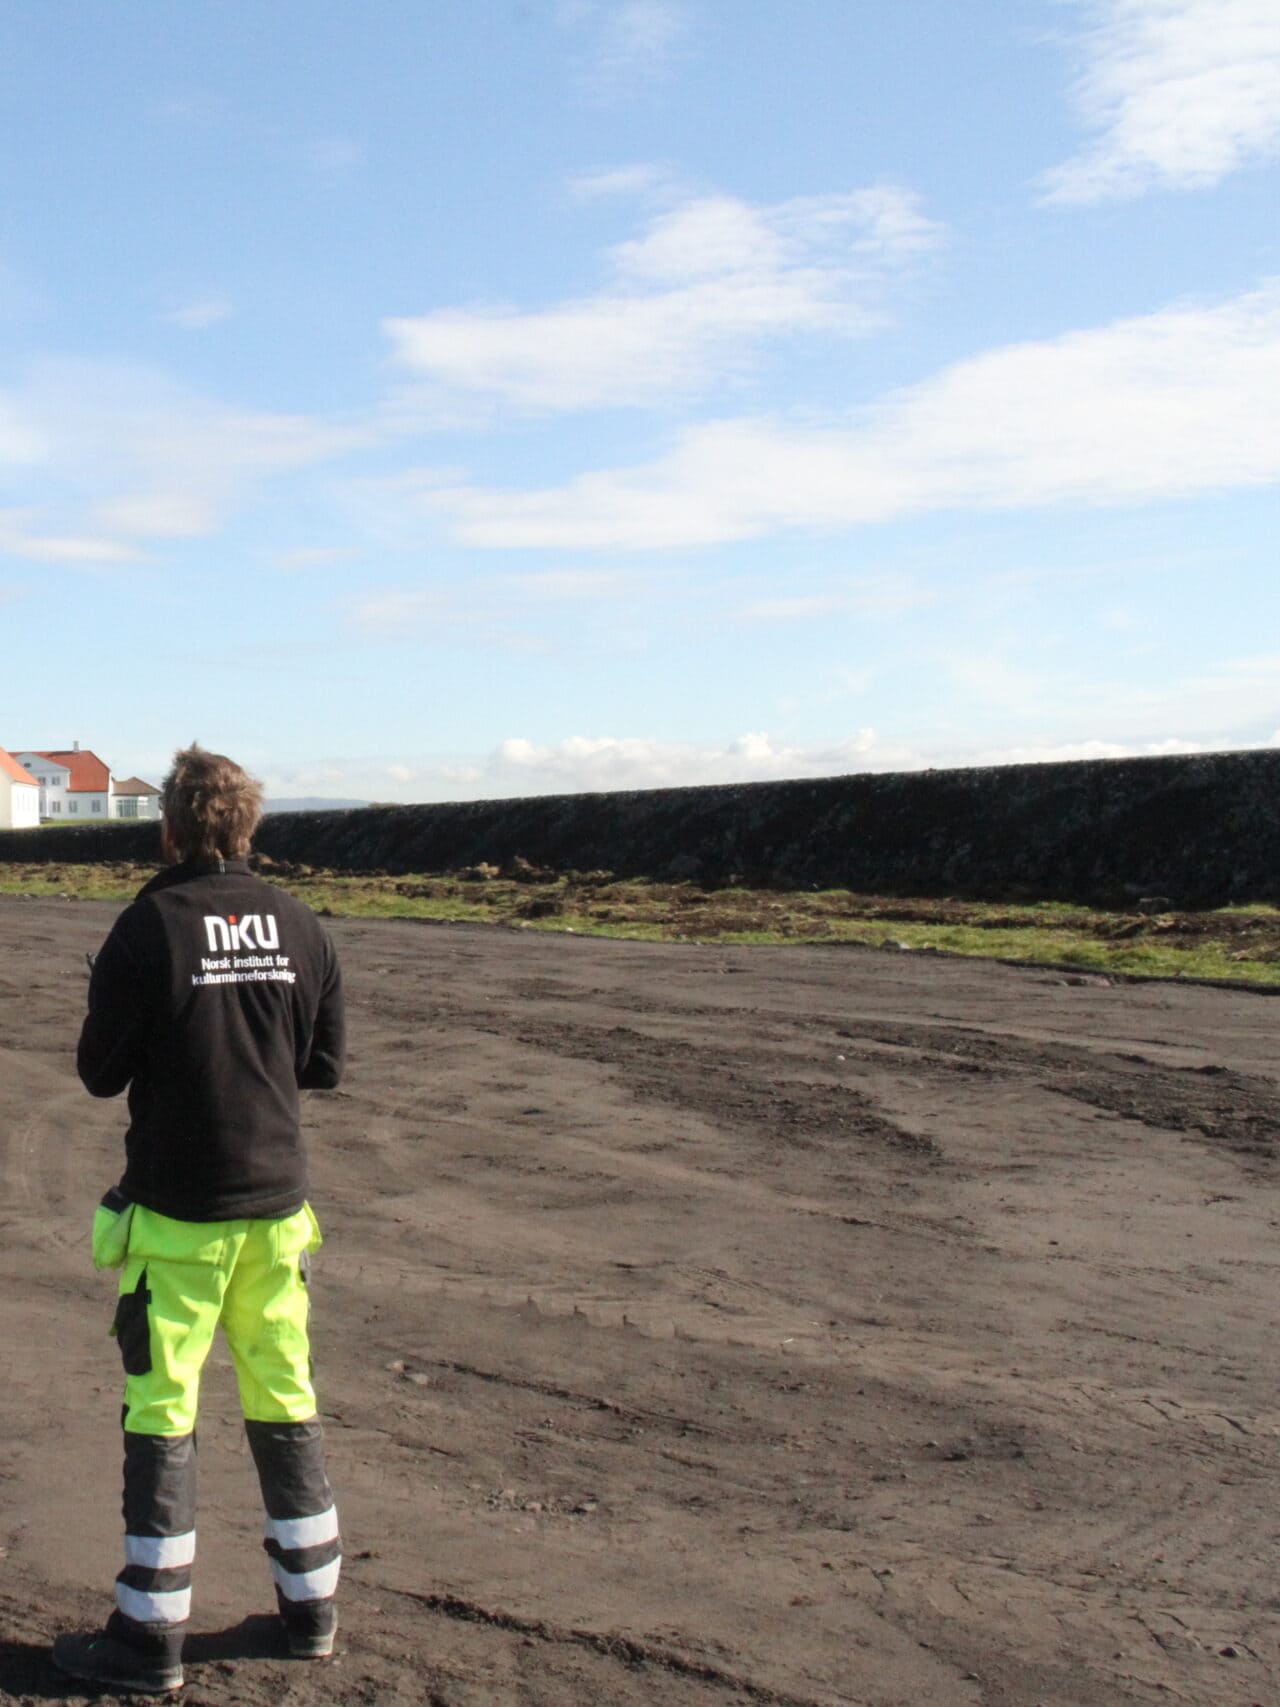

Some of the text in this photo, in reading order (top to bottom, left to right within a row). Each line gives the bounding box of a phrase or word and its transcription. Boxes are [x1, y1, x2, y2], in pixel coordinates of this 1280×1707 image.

[201, 954, 289, 970] Norsk institutt for
[192, 968, 296, 985] kulturminneforskning
